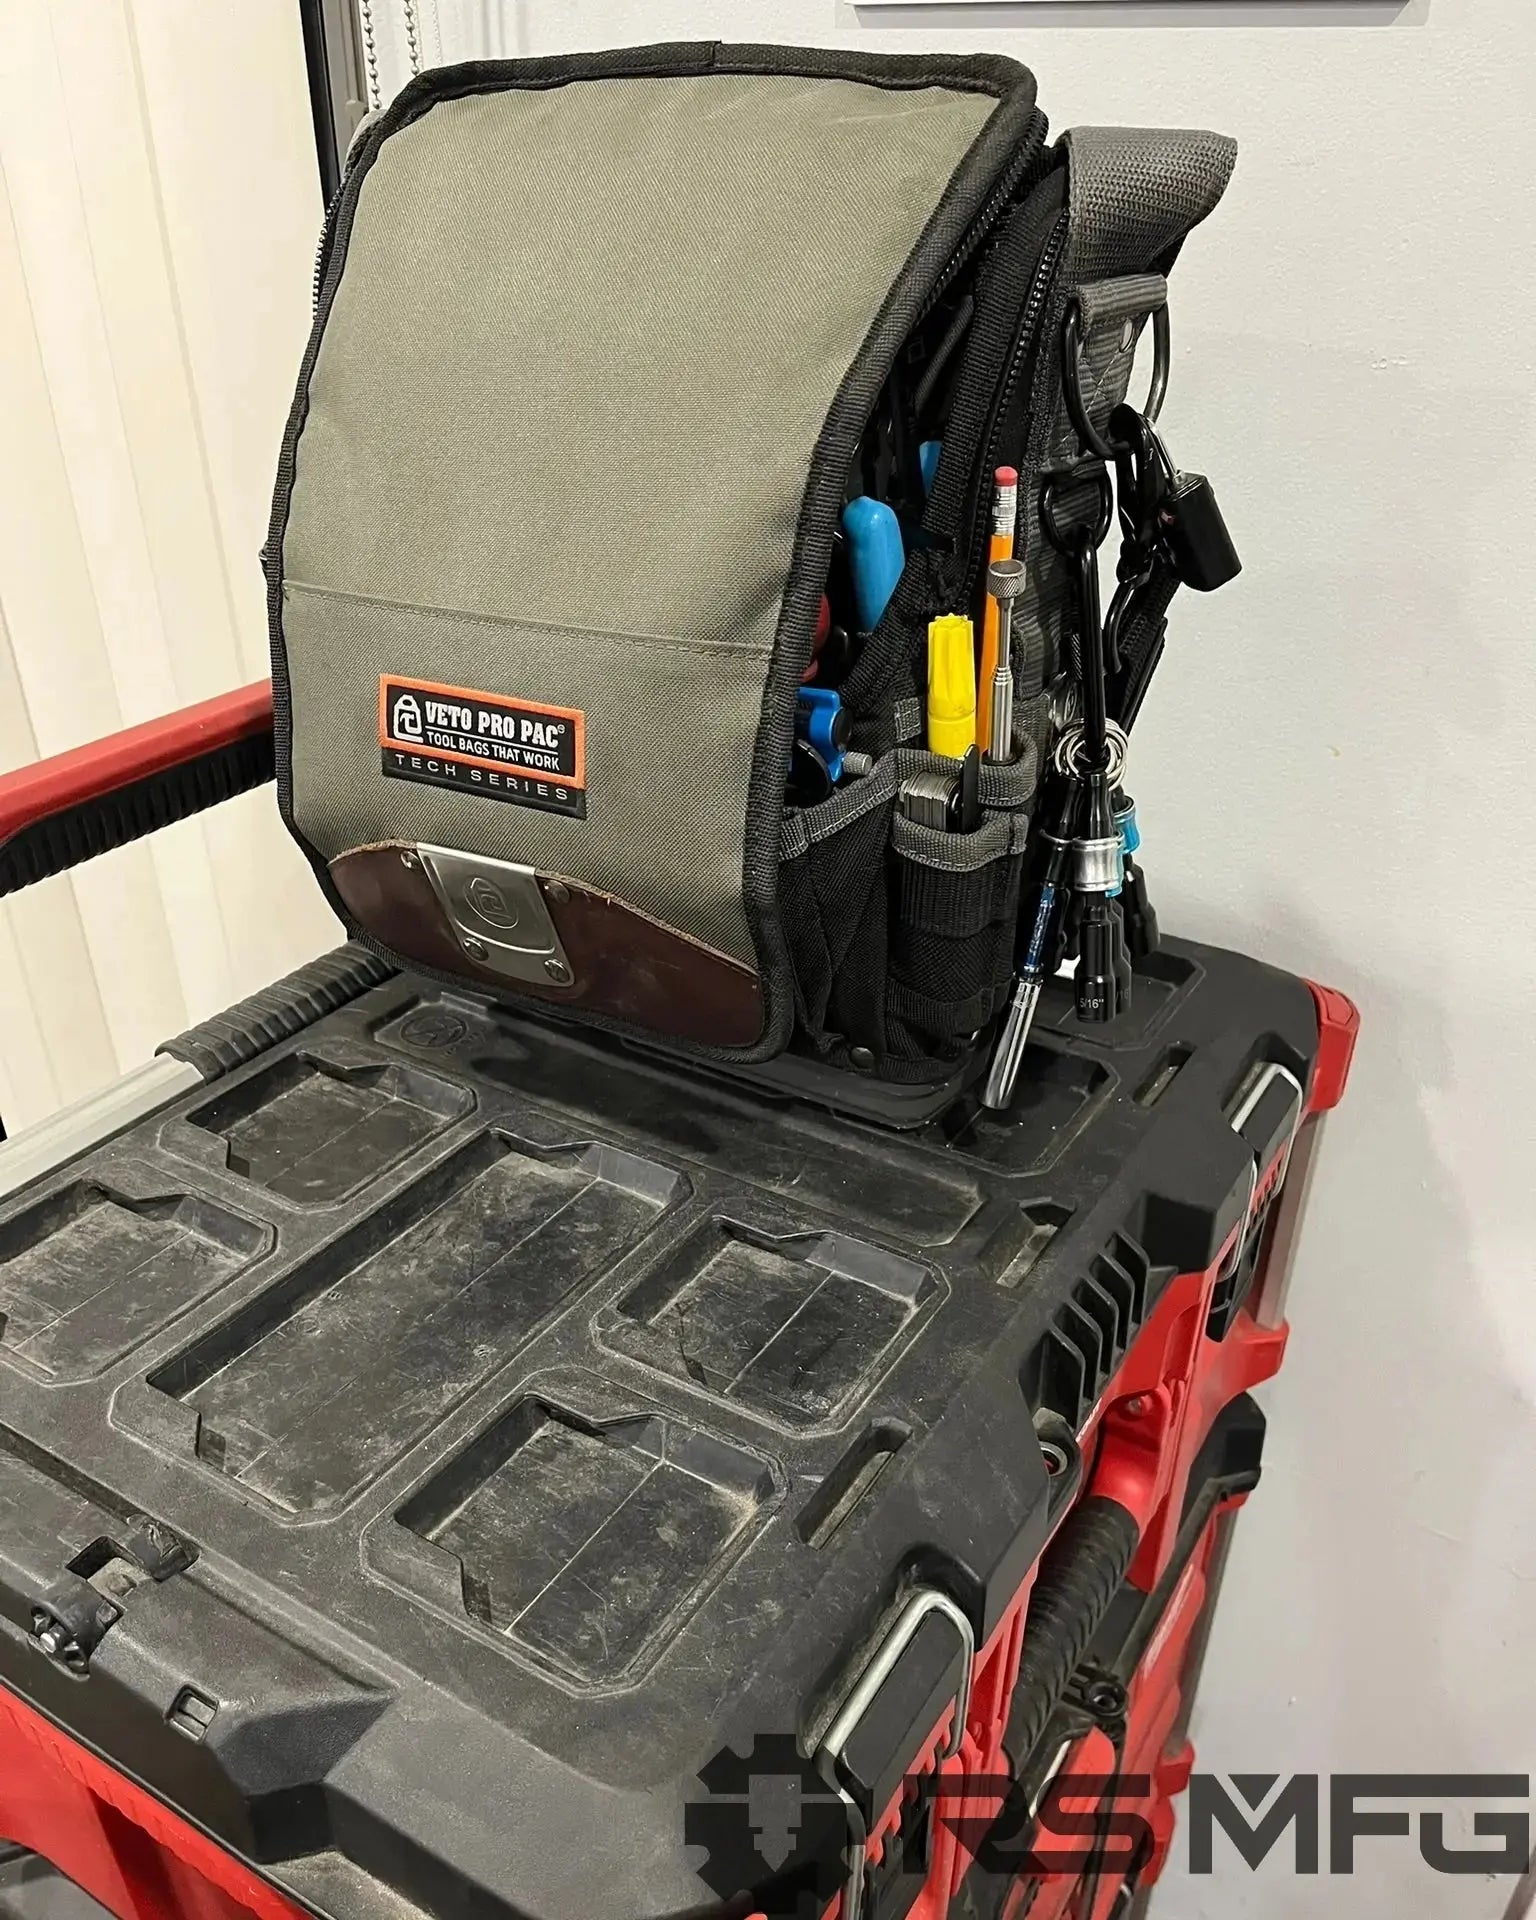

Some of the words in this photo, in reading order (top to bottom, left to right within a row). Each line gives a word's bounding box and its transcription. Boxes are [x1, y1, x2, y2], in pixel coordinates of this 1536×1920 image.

[425, 701, 472, 731] VETO
[478, 711, 515, 739] PRO
[426, 731, 457, 749] TOOL
[459, 739, 490, 756] BAGS
[492, 744, 520, 762] THAT
[522, 751, 560, 771] WORK
[395, 754, 456, 776] TECH
[470, 770, 568, 800] SERIES
